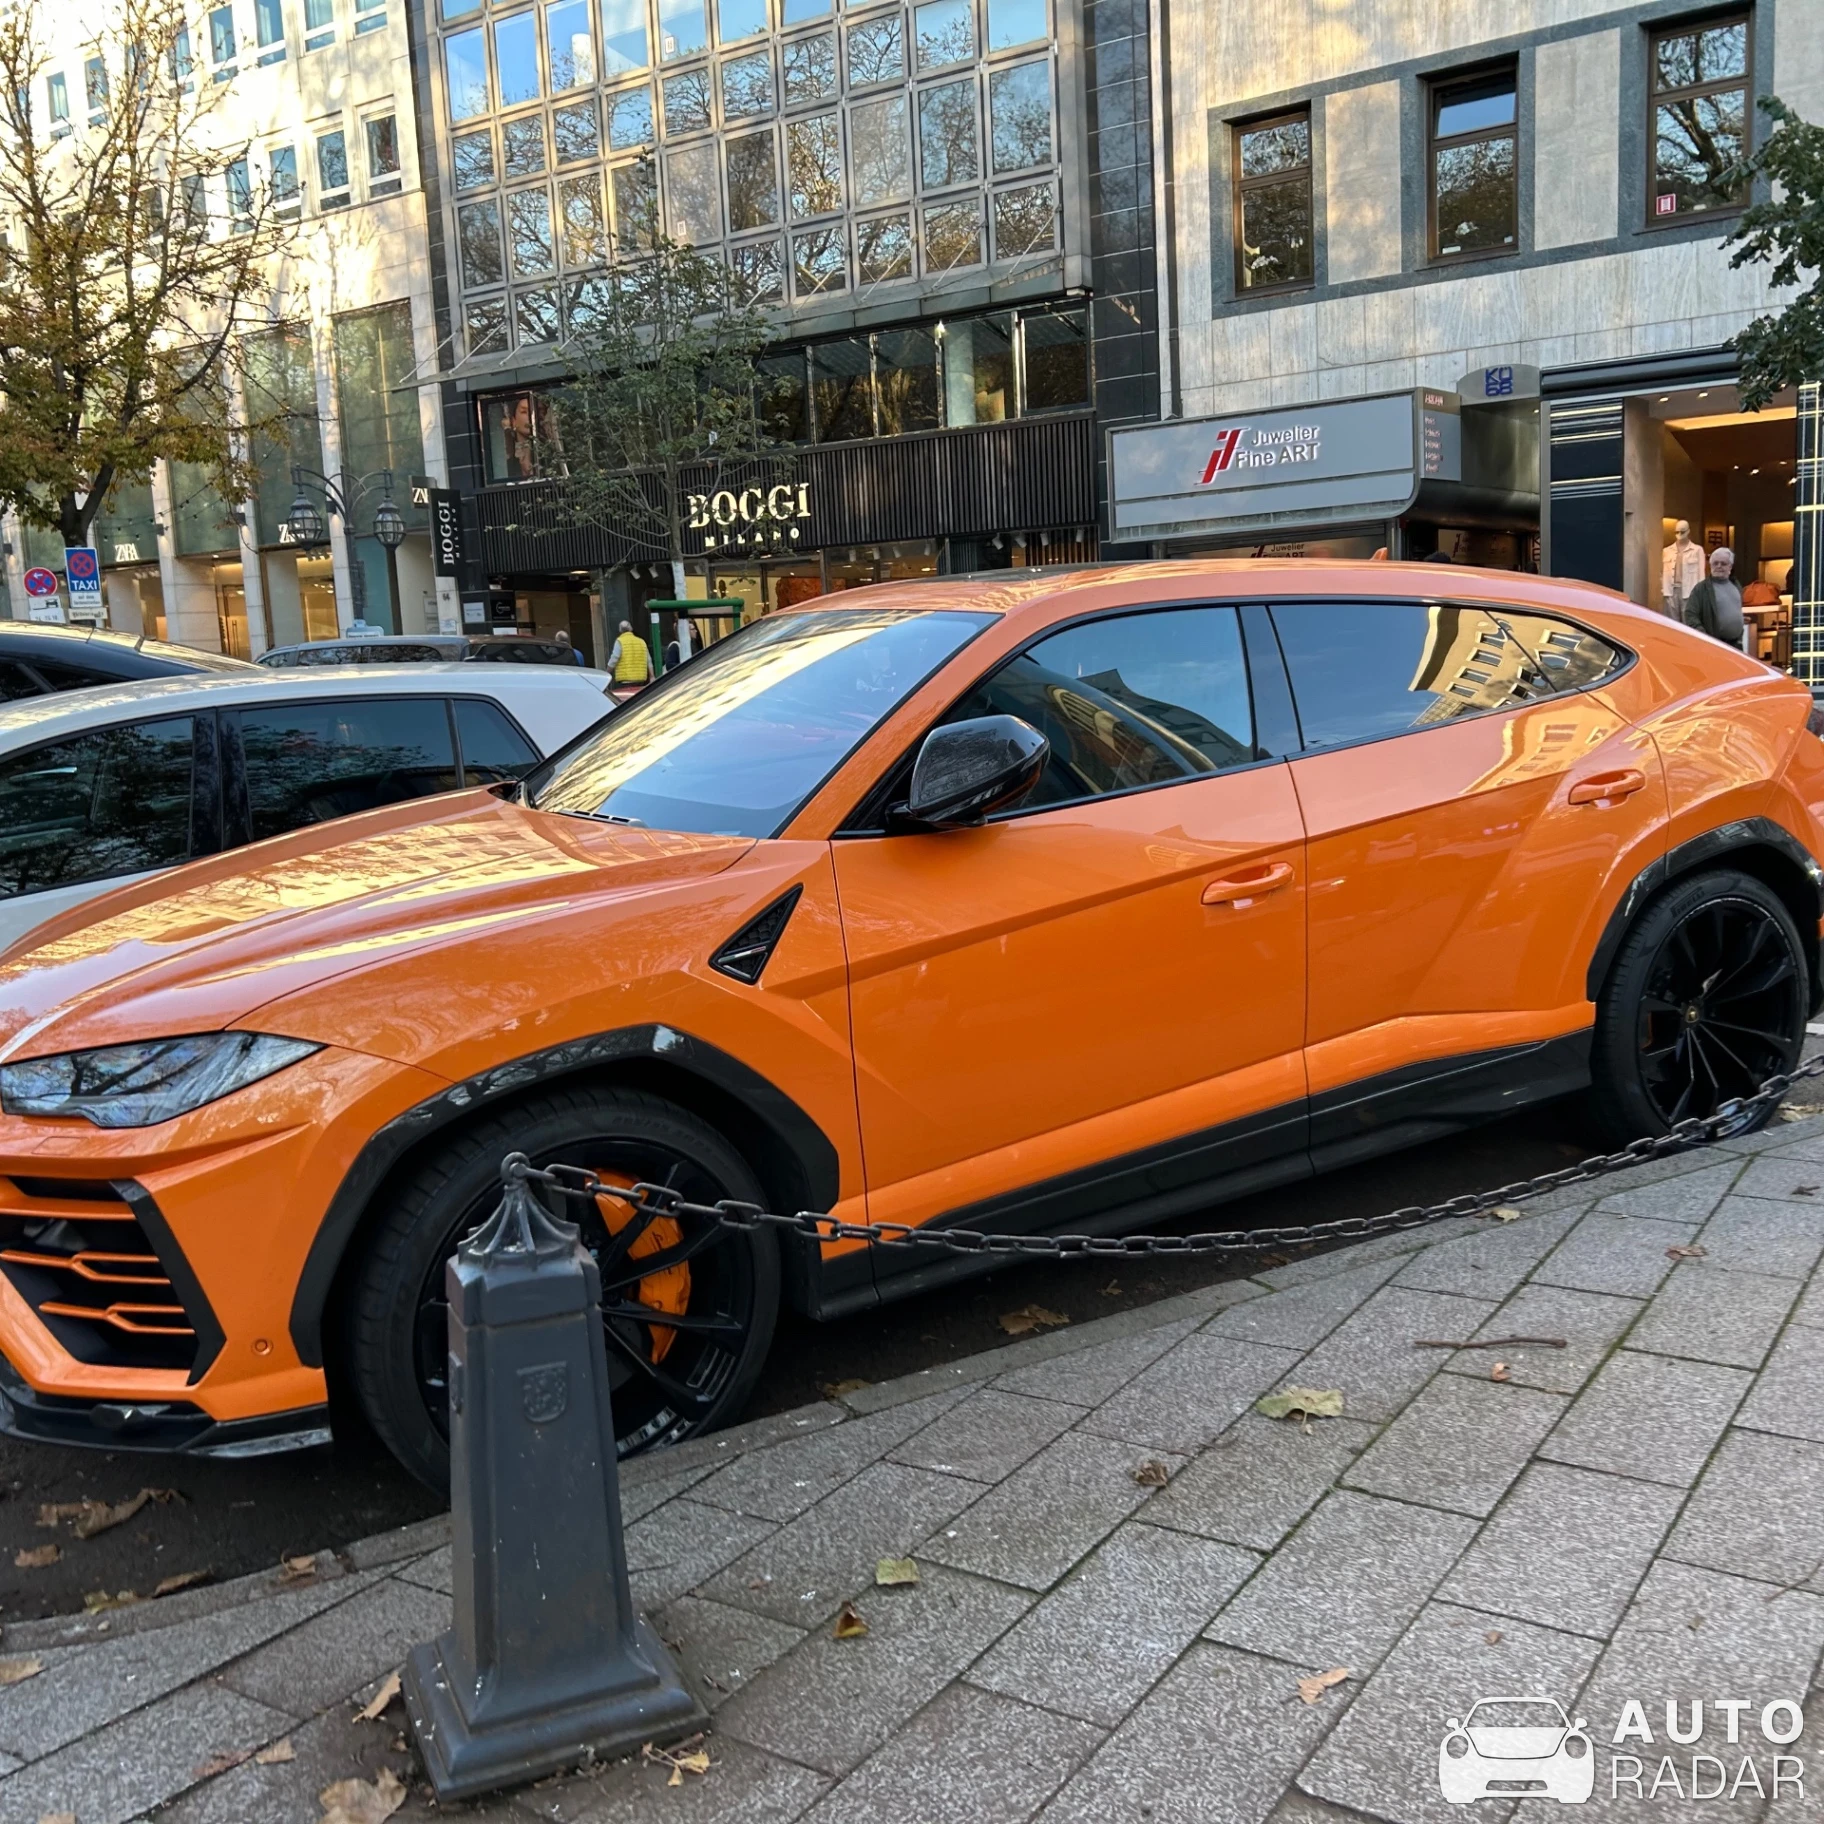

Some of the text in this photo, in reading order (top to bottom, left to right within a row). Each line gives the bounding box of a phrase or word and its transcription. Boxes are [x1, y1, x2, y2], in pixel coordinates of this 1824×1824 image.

[1251, 425, 1320, 447] Juwelier
[1235, 442, 1320, 468] Fine ART
[686, 482, 811, 528] BOGGI
[438, 500, 455, 565] BOGGI
[114, 543, 140, 562] ZARA
[71, 580, 98, 591] TAXI
